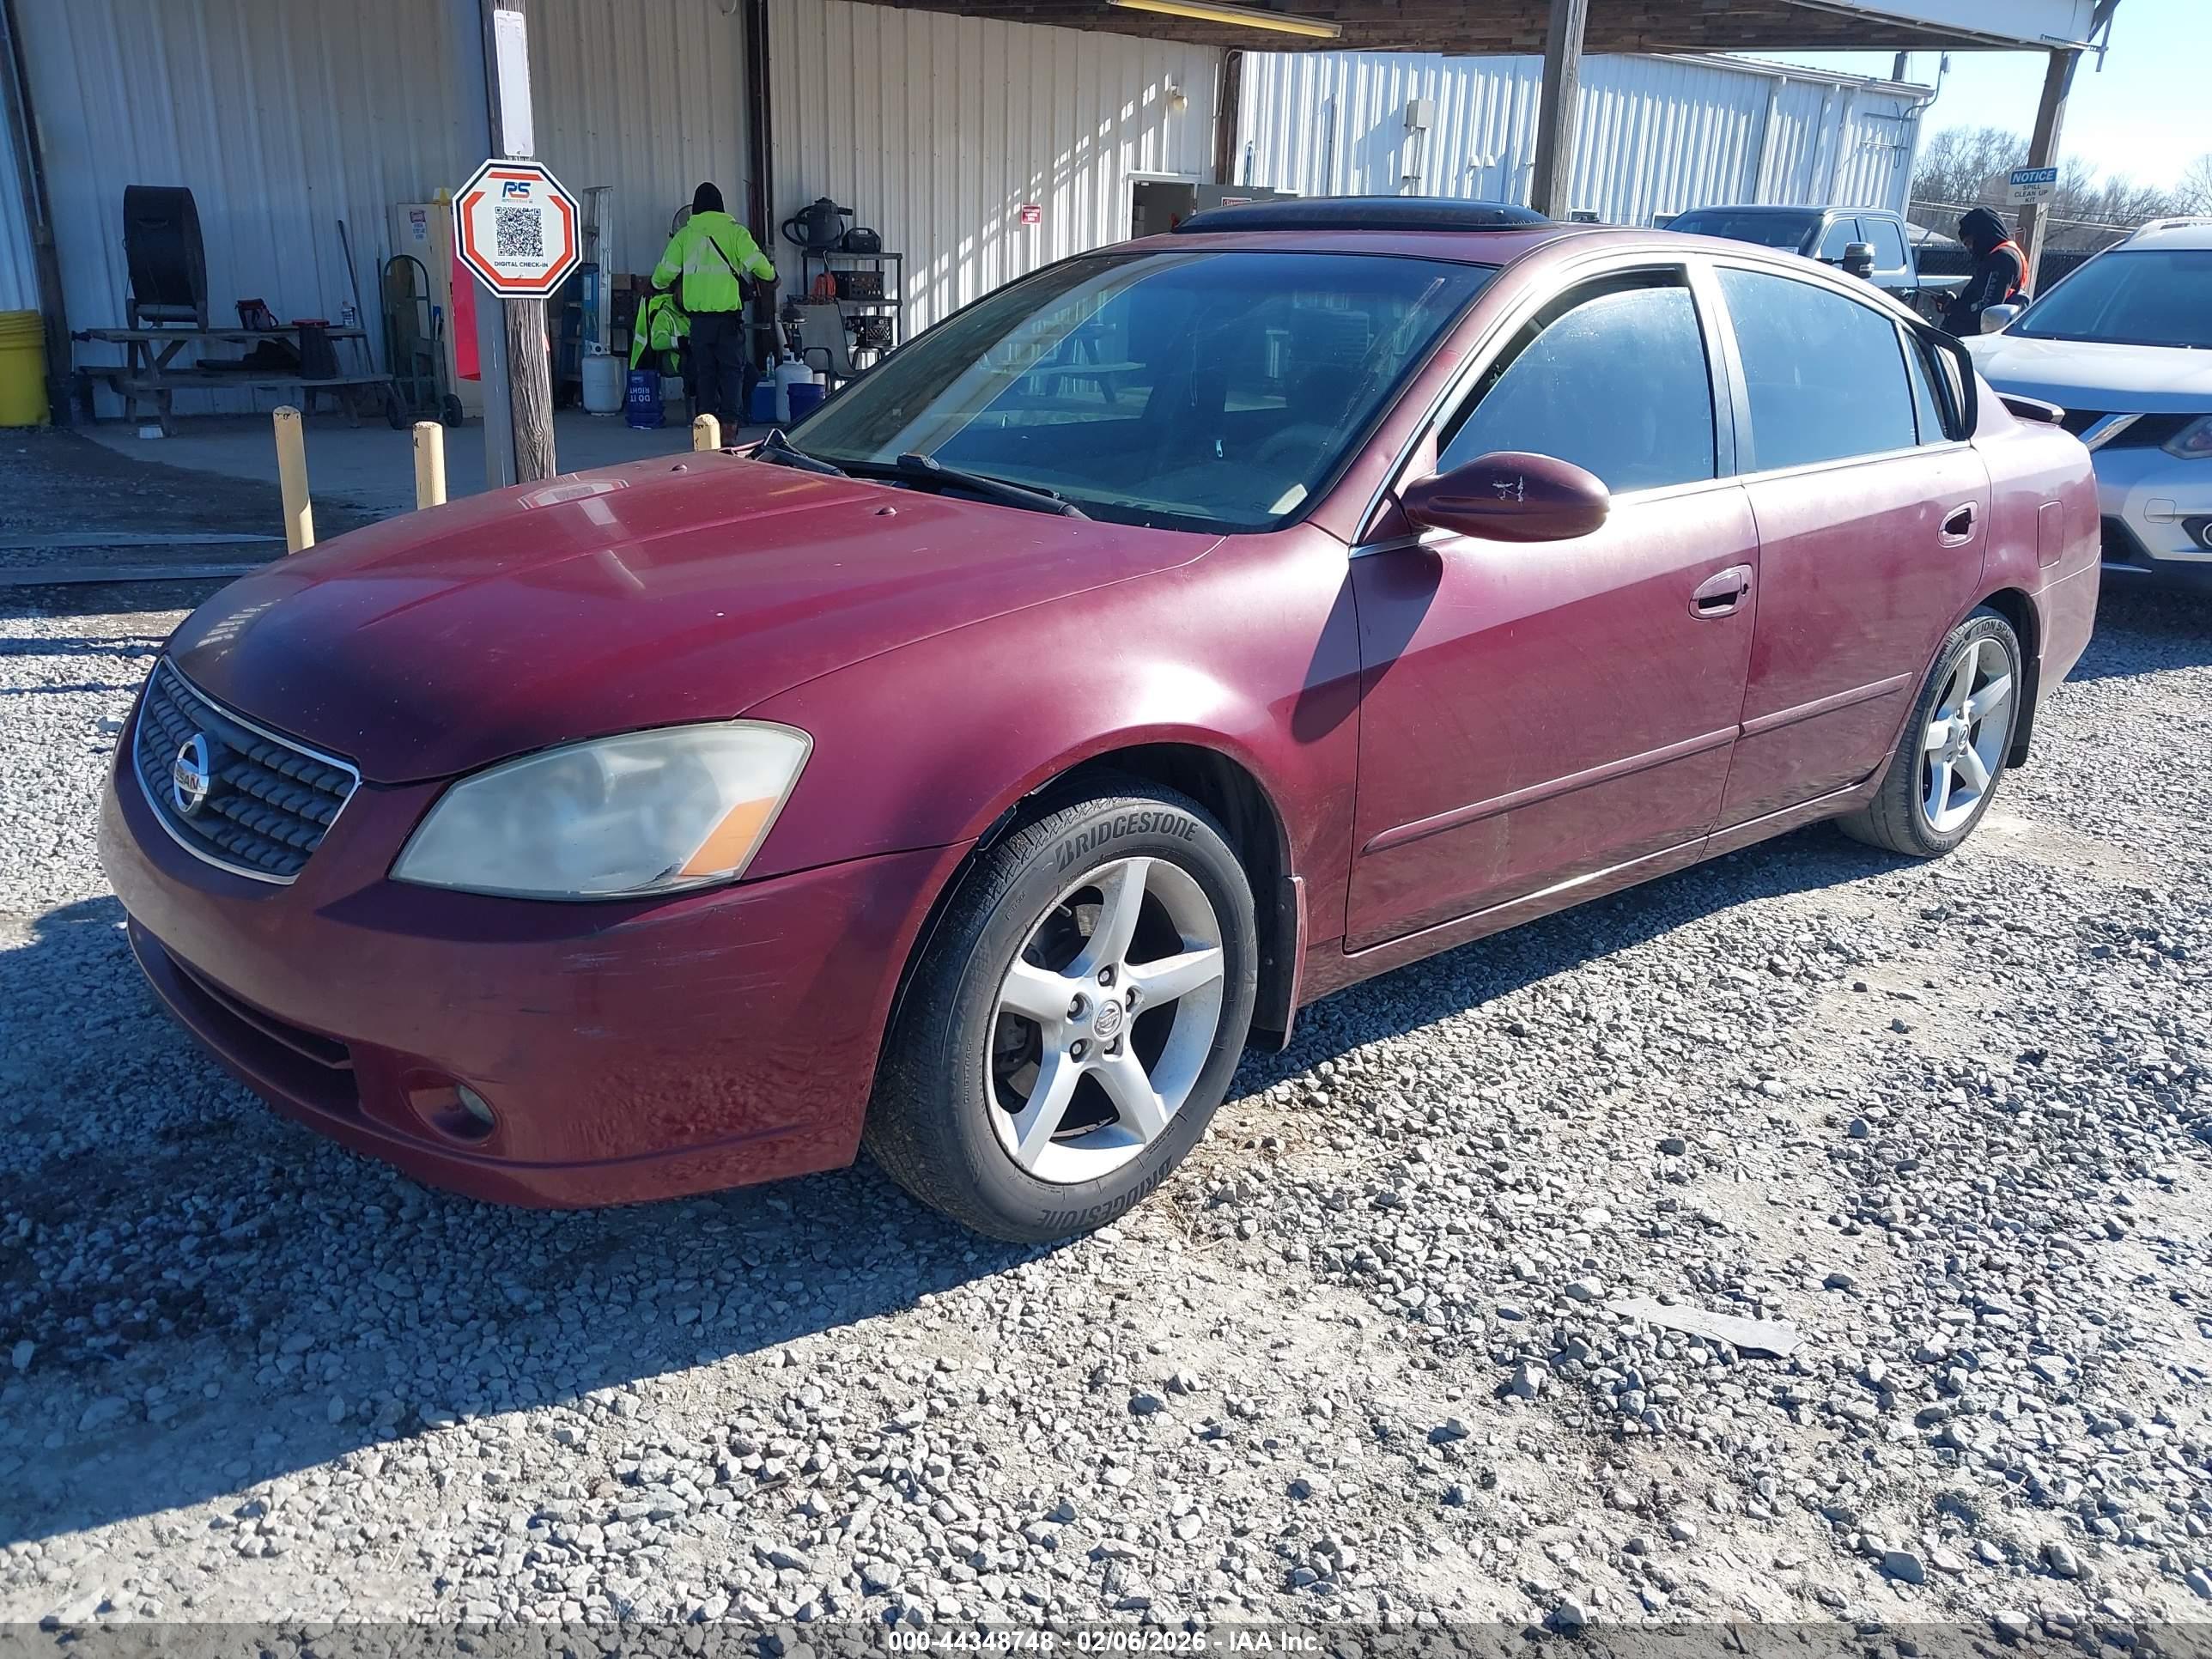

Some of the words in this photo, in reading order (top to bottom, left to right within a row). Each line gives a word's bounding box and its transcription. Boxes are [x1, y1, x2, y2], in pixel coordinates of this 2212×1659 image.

[2012, 170, 2055, 183] NOTICE
[629, 386, 650, 395] RIGHT
[630, 394, 637, 403] IT
[638, 394, 651, 403] DO
[1055, 811, 1199, 873] BRIDGESTONE
[1036, 1155, 1172, 1230] BRIDGESTONE
